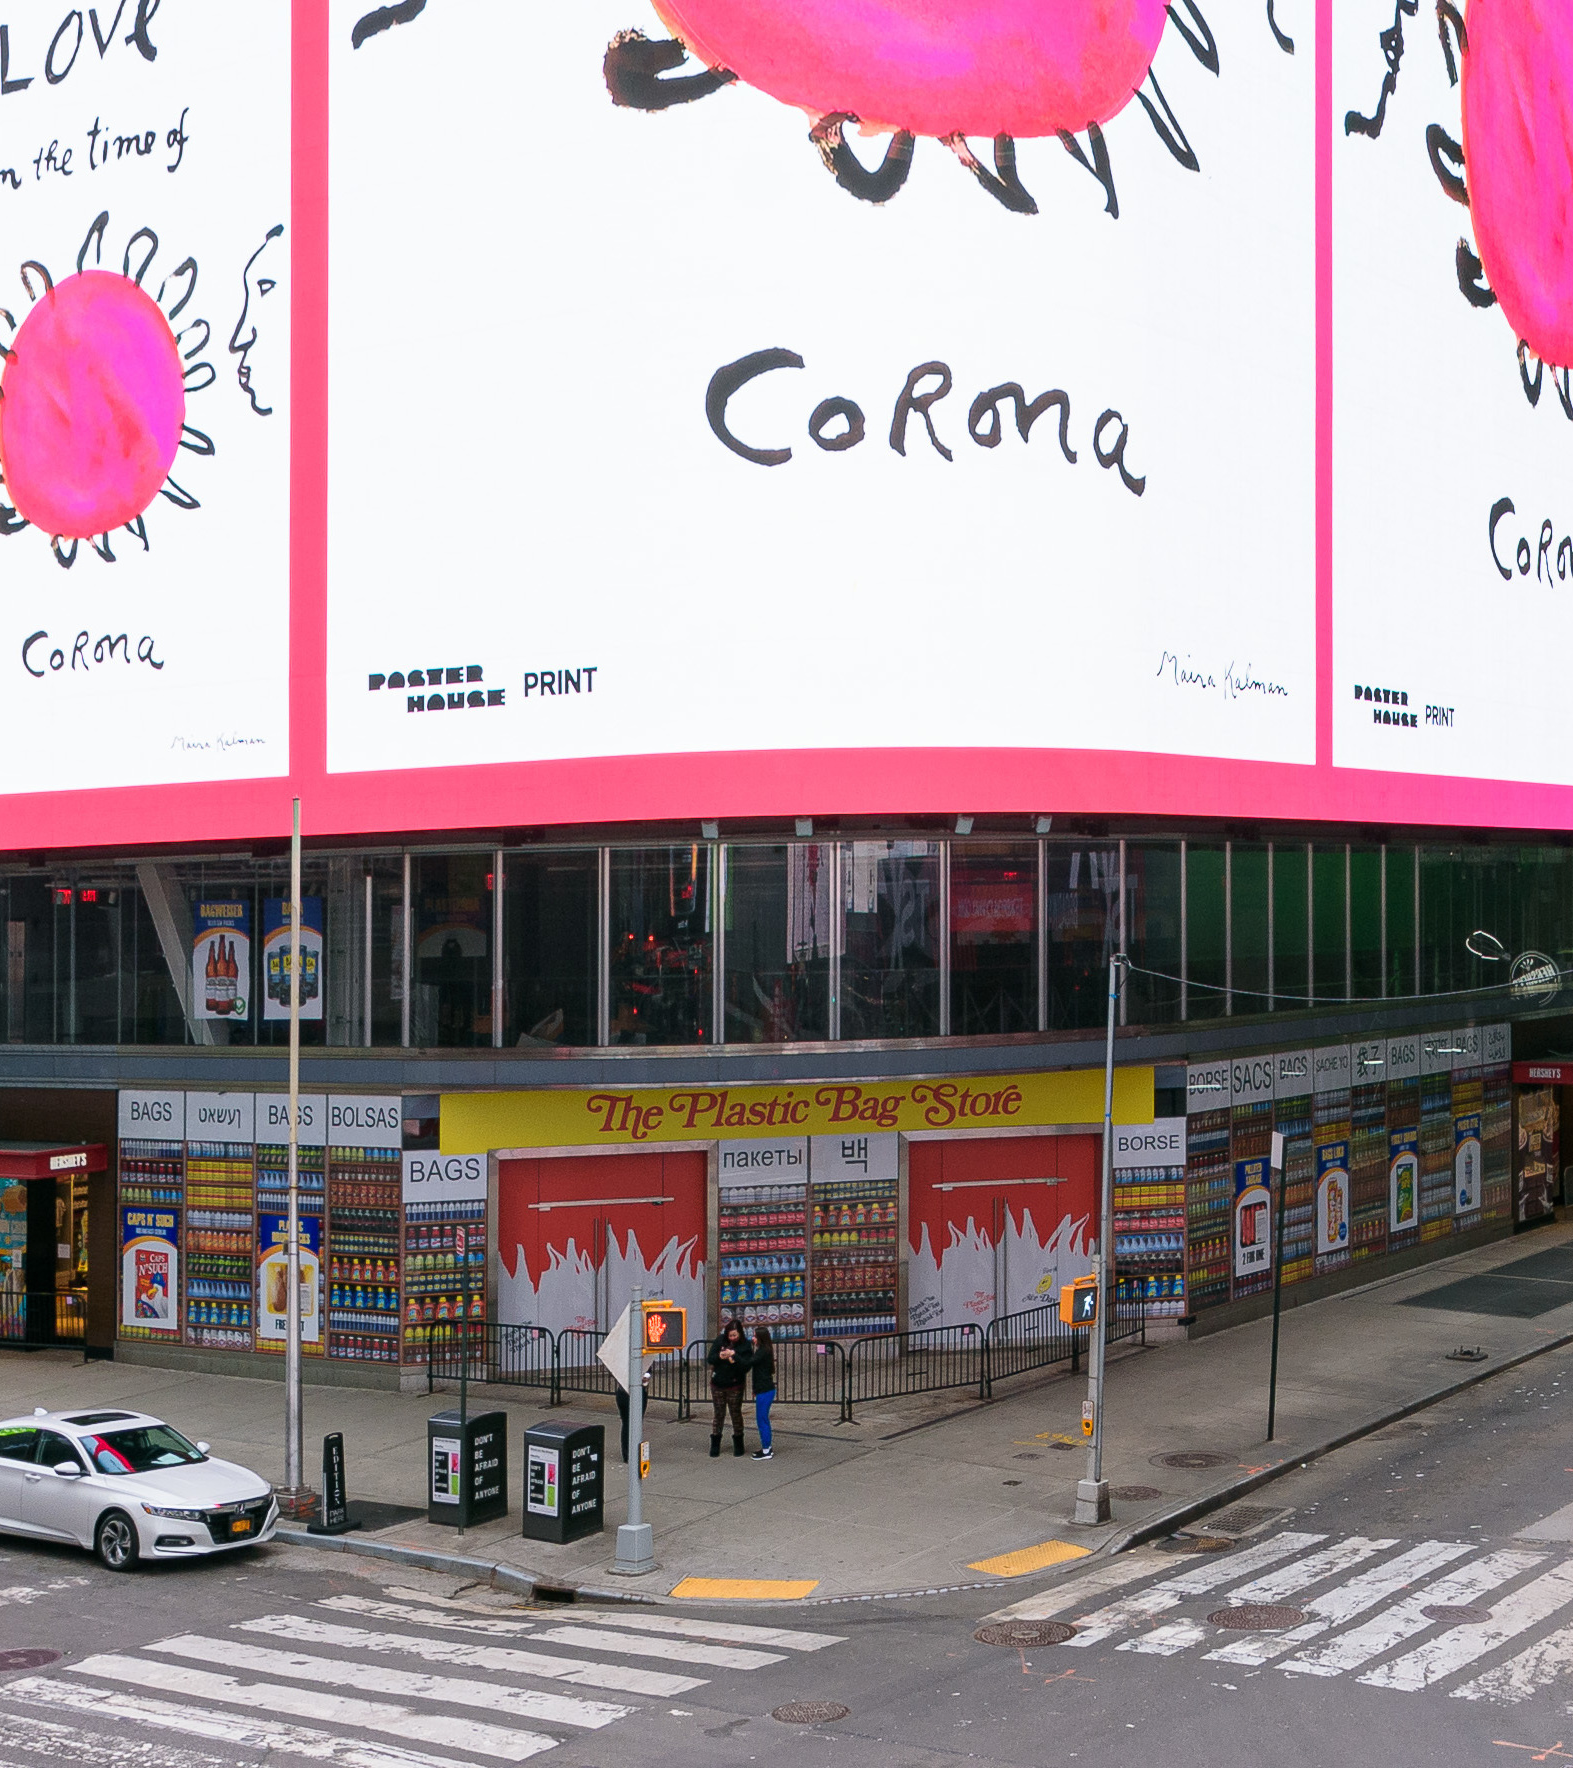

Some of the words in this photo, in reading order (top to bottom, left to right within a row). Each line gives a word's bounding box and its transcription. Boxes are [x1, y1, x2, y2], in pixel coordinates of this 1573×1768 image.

[34, 140, 72, 180] the
[87, 117, 155, 162] time
[167, 108, 189, 172] of
[524, 665, 598, 696] PRINT
[1426, 705, 1455, 728] PRINT
[1391, 1044, 1415, 1066] BAGS
[1233, 1060, 1272, 1094] SACS
[1279, 1055, 1308, 1080] BAGS
[1529, 1067, 1562, 1080] HERSHEY'S
[1189, 1068, 1229, 1096] BORSE
[131, 1101, 173, 1123] BAGS
[332, 1105, 399, 1130] BOLSAS
[585, 1093, 665, 1140] The
[669, 1090, 810, 1130] Plastic
[815, 1086, 906, 1127] Bag
[910, 1083, 1023, 1127] Store
[841, 1137, 869, 1173] 백
[1117, 1133, 1180, 1155] BORSE
[723, 1145, 804, 1171] пакеты
[410, 1157, 481, 1183] BAGS
[474, 1433, 494, 1446] DON'T
[474, 1449, 484, 1460] BE
[572, 1445, 592, 1459] DON'T
[474, 1457, 499, 1472] AFRAID
[572, 1462, 581, 1473] BE
[474, 1476, 484, 1487] OF
[572, 1470, 596, 1485] AFRAID
[474, 1486, 500, 1501] ANYONE
[572, 1489, 581, 1500] OF
[571, 1499, 597, 1515] ANYONE
